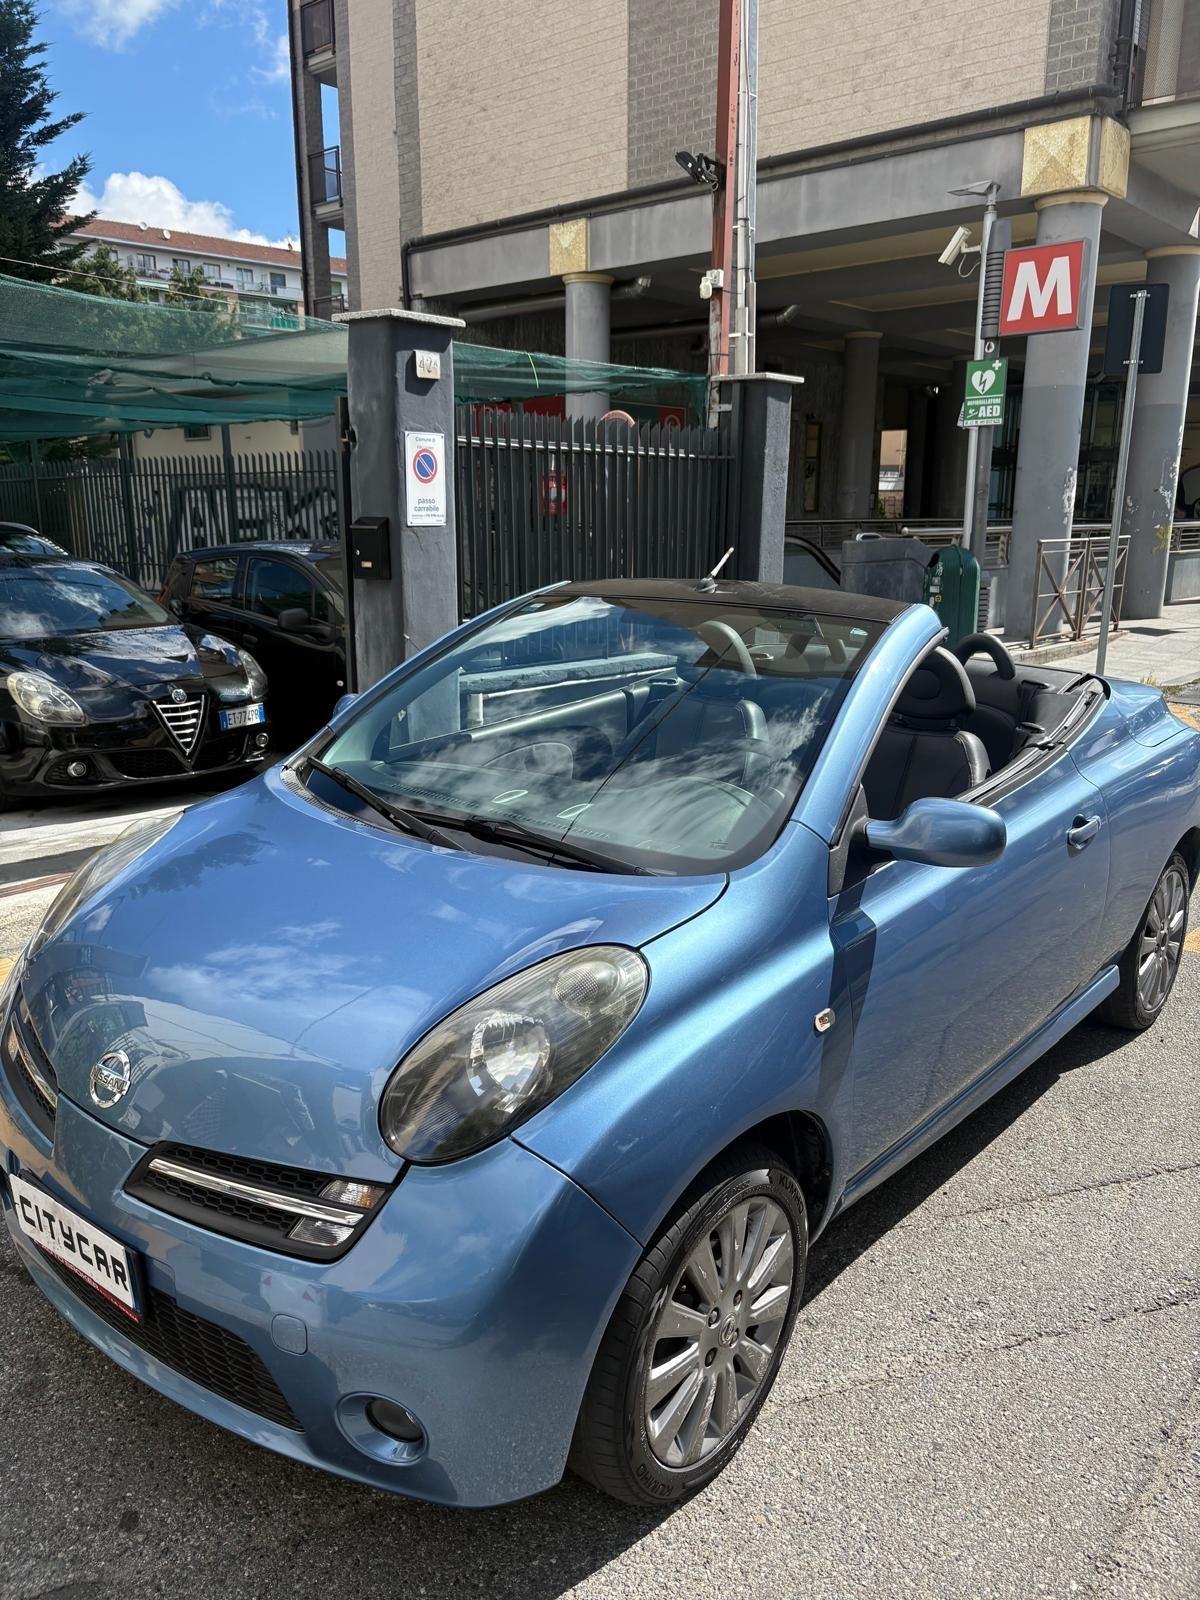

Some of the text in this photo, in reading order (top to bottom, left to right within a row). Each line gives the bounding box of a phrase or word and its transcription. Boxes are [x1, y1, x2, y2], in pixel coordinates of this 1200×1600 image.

[1006, 255, 1072, 322] M
[978, 405, 1001, 418] AED
[414, 505, 440, 513] carrabile
[91, 1065, 127, 1091] NISSAN
[779, 1174, 804, 1214] KUMHO
[18, 1194, 129, 1292] CITYCAR
